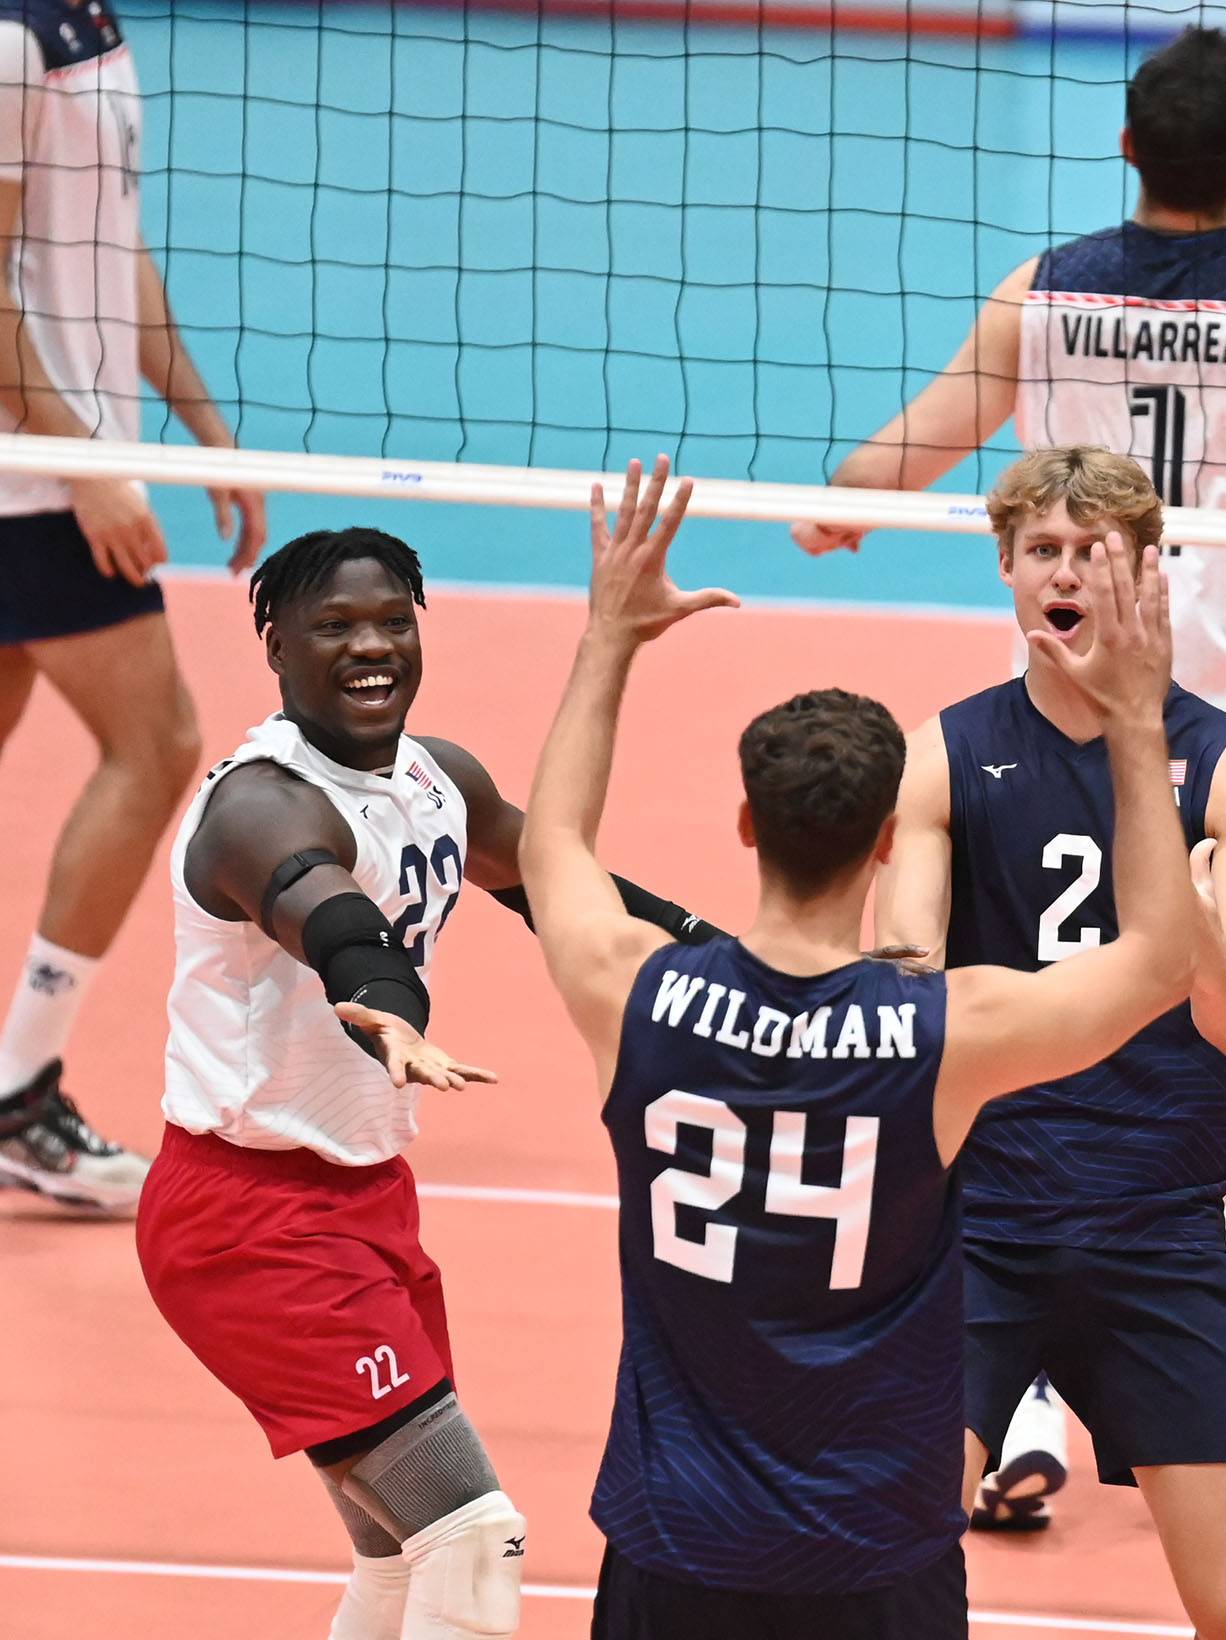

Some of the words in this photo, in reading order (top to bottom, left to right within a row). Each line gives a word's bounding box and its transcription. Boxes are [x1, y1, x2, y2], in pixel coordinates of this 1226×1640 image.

[1038, 833, 1102, 961] 2
[651, 969, 918, 1059] WILDMAN
[644, 1089, 880, 1290] 24
[355, 1344, 410, 1400] 22
